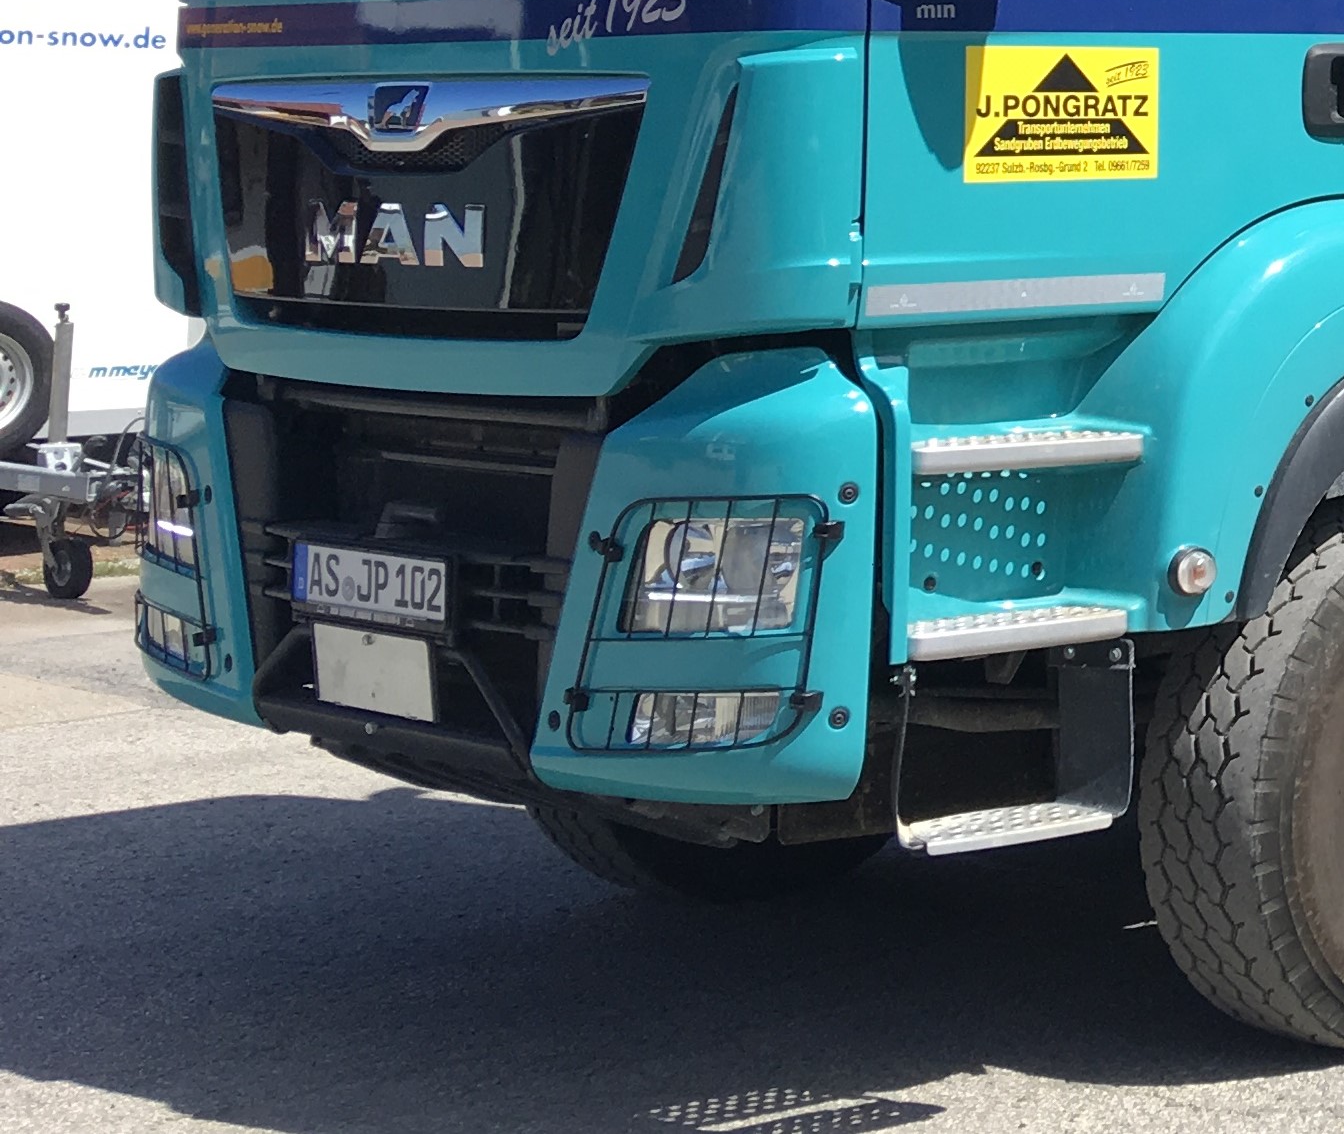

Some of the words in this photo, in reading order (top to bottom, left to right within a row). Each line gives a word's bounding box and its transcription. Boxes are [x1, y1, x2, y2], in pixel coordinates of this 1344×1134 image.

[1106, 72, 1121, 85] seit
[1125, 64, 1149, 77] 1923
[975, 95, 1149, 118] J.PONGRATZ
[1017, 121, 1111, 136] Transportunternehmen
[994, 137, 1043, 153] Sandgruben
[1045, 136, 1128, 152] Erdbewegungsbetrieb
[976, 162, 1000, 175] 92237
[1083, 161, 1088, 172] 2
[1094, 160, 1106, 172] Tel.
[303, 198, 485, 268] MAN
[309, 552, 340, 597] AS
[357, 559, 389, 604] JP
[394, 564, 442, 612] 102
